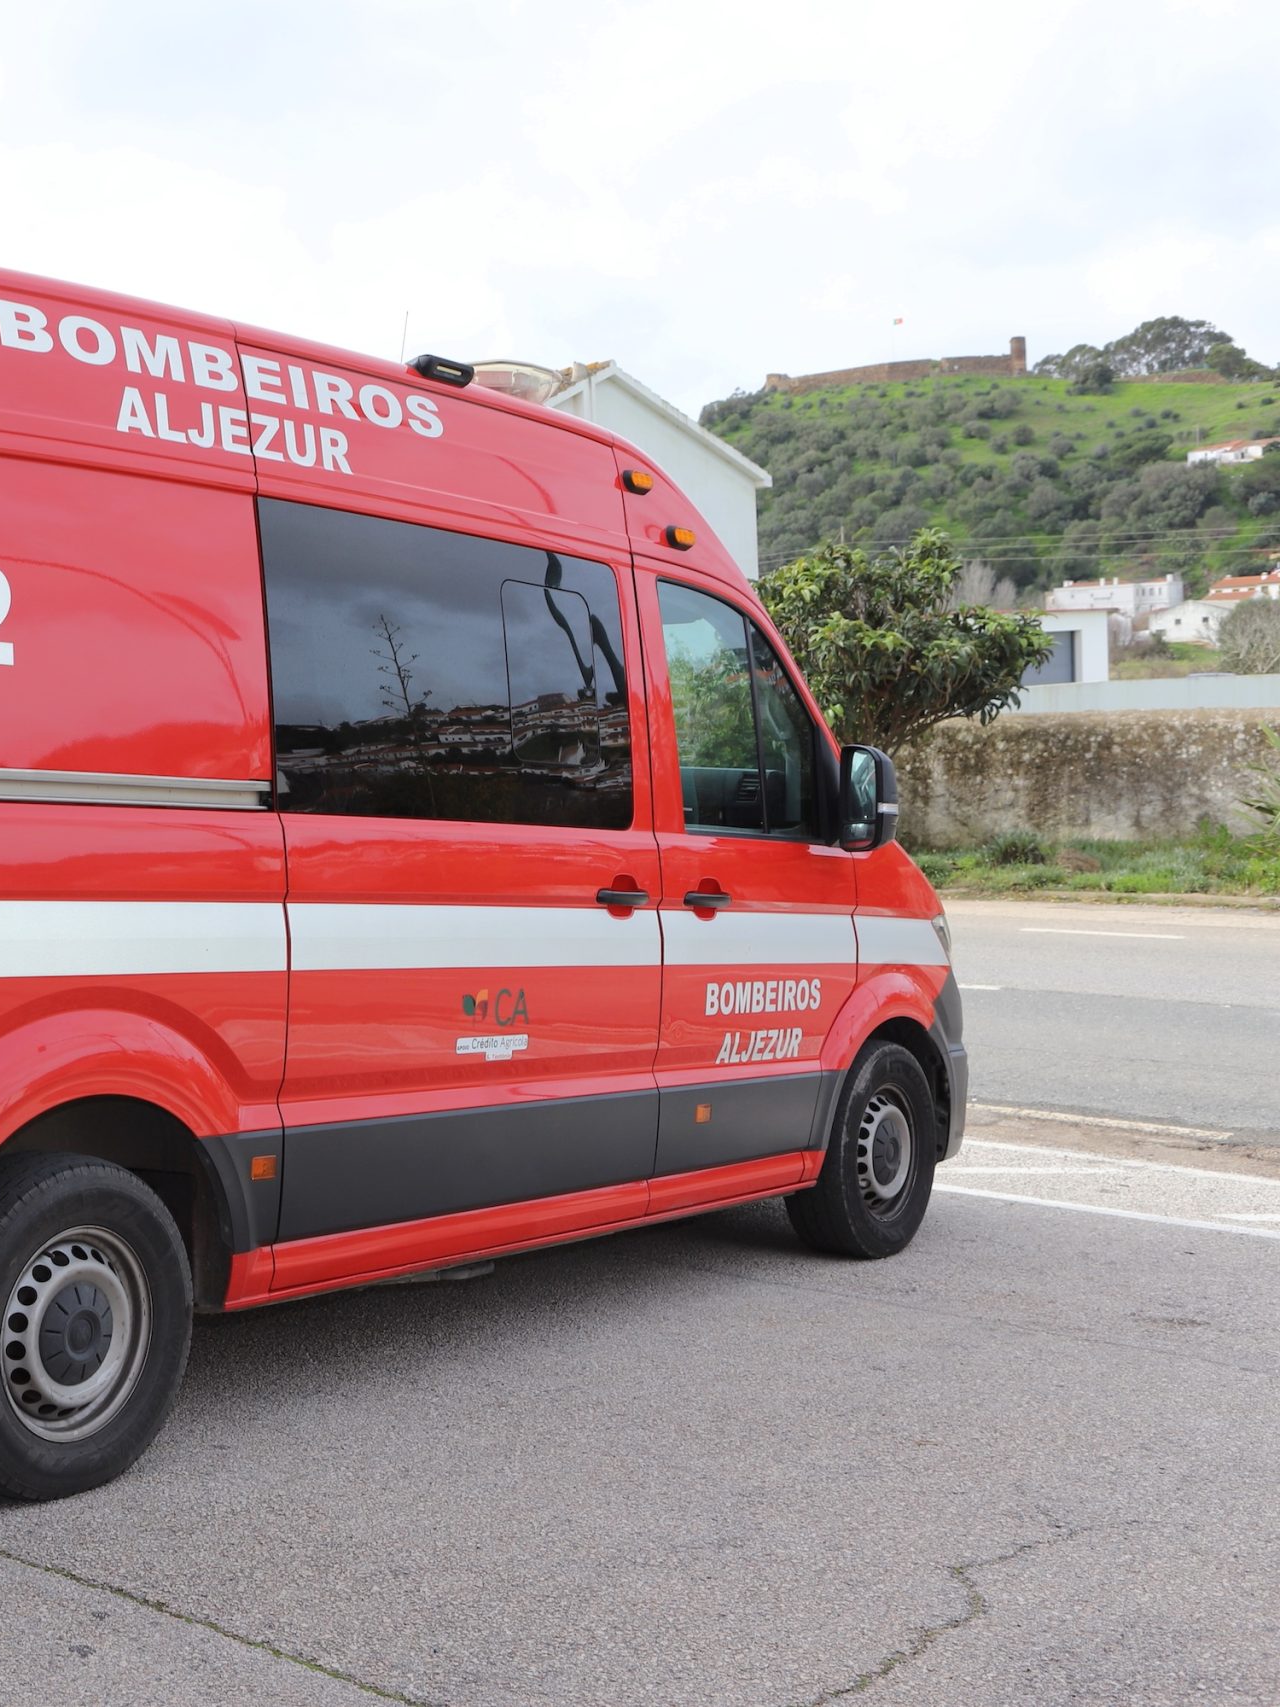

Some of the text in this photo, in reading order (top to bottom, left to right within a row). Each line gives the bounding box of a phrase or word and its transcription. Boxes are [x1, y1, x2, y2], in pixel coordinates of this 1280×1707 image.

[116, 386, 354, 475] ALJEZUR
[495, 988, 529, 1027] CA
[705, 978, 821, 1016] BOMBEIROS
[715, 1027, 803, 1065] ALJEZUR
